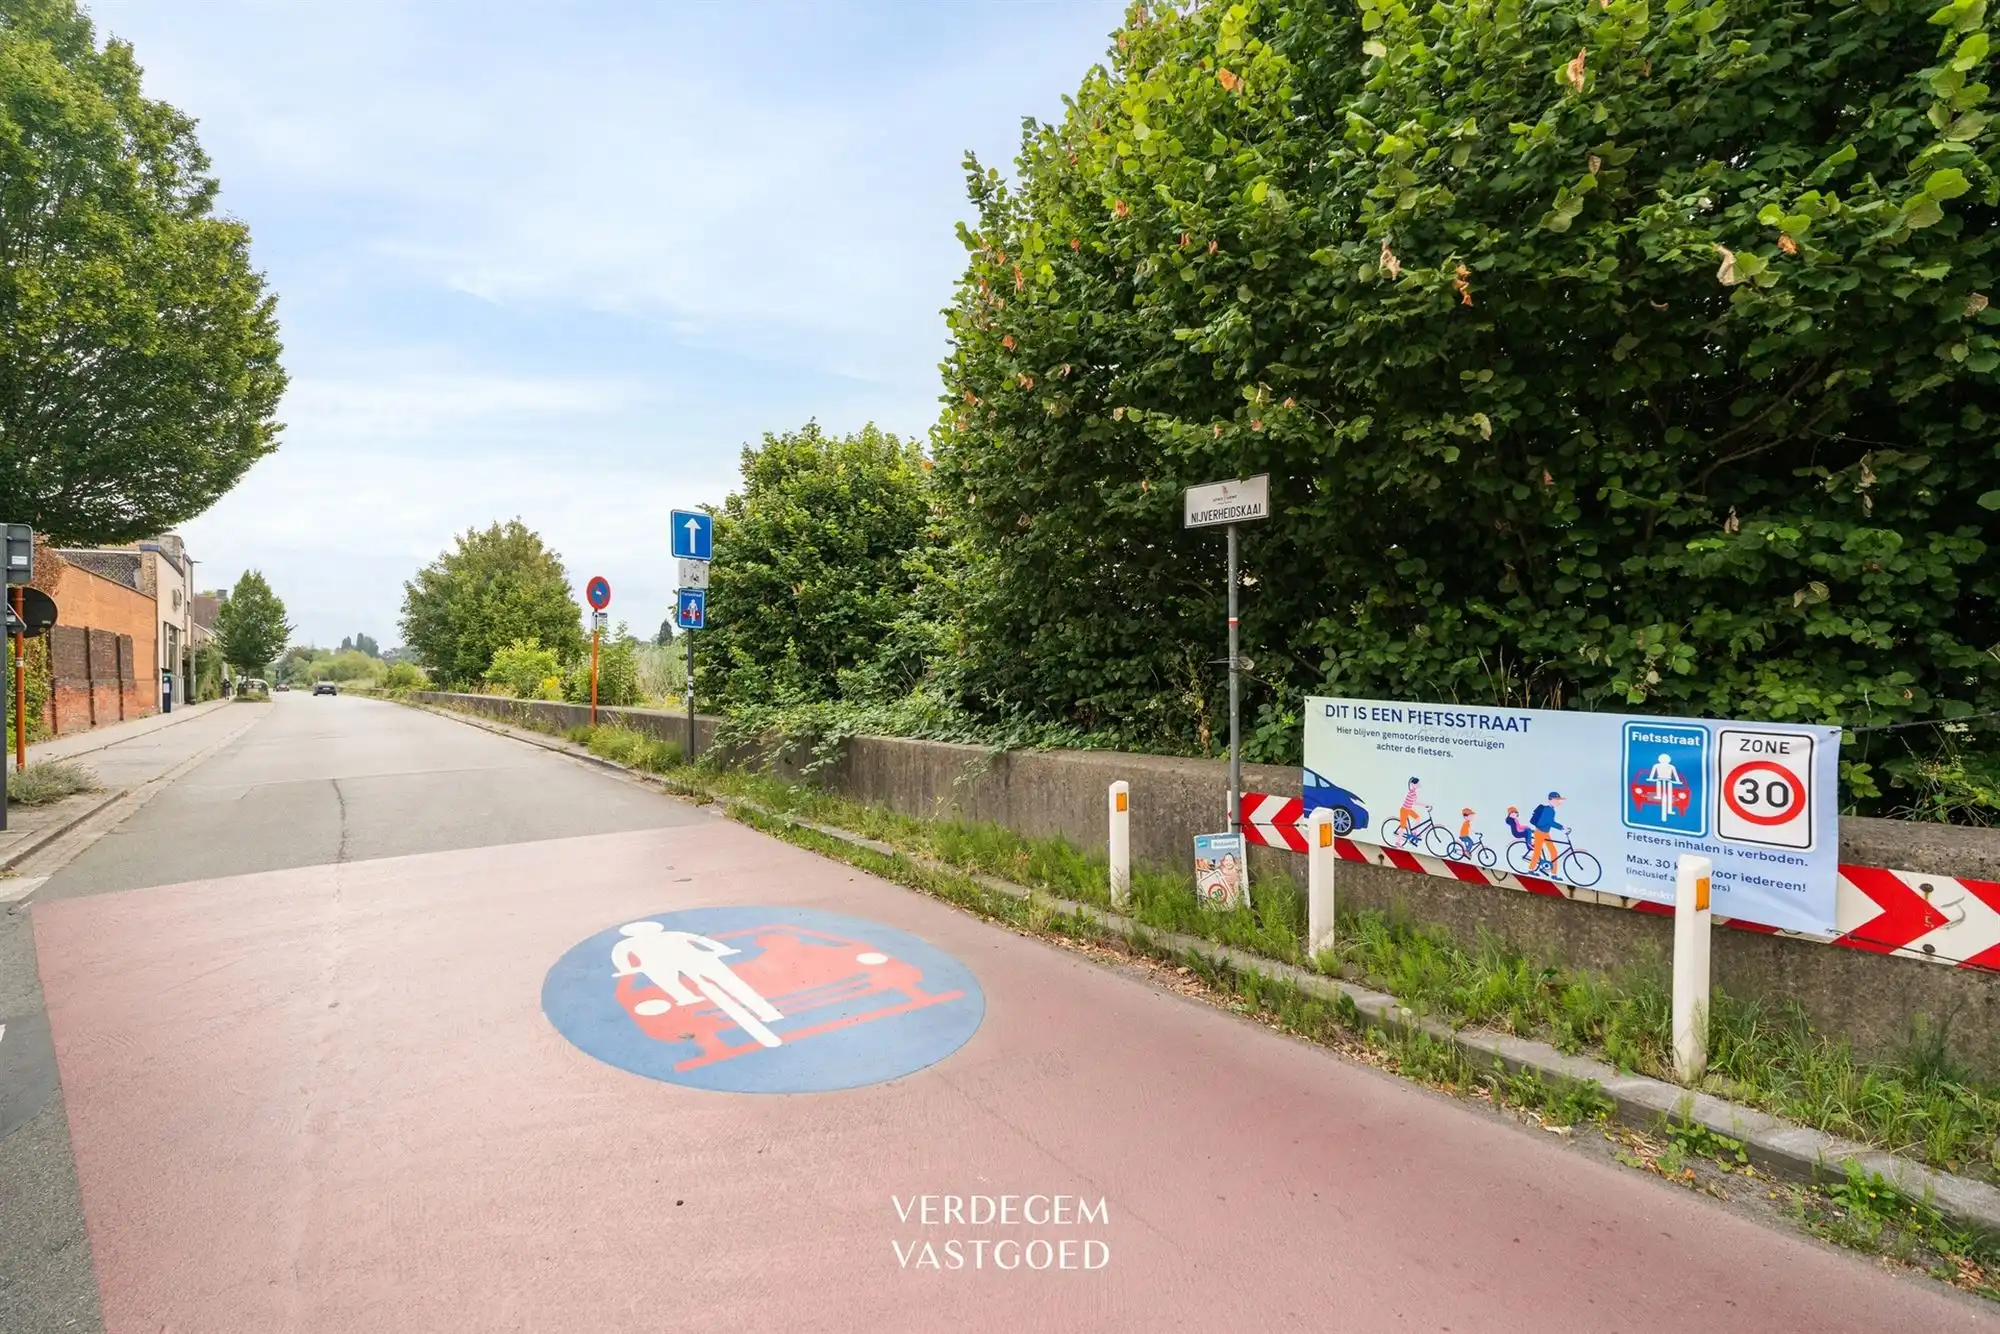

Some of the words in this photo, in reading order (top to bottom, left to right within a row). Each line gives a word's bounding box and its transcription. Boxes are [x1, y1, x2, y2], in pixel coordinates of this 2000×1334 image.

[1191, 503, 1261, 524] NIJVERHEIDSKAAI
[1325, 704, 1349, 719] DIT
[1353, 706, 1367, 720] IS
[1372, 708, 1402, 723] EEN
[1408, 709, 1532, 733] FIETSSTRAAT
[1336, 725, 1352, 736] Hier
[1353, 727, 1381, 738] blijven
[1382, 731, 1451, 745] gemotoriseerde
[1452, 737, 1505, 750] voertuigen
[1631, 731, 1700, 746] Fietsstraat
[1739, 738, 1791, 755] ZONE
[1376, 742, 1403, 753] achter
[1404, 744, 1416, 754] de
[1417, 745, 1454, 758] fietsers.
[1737, 778, 1789, 808] 30
[1626, 831, 1672, 847] Fietsers
[1674, 838, 1720, 855] inhalen
[1724, 845, 1734, 856] is
[1737, 849, 1809, 867] verboden.
[1626, 854, 1652, 867] Max.
[1655, 860, 1670, 869] 30
[1741, 872, 1807, 893] iedereen!
[1626, 867, 1668, 882] (inclusief
